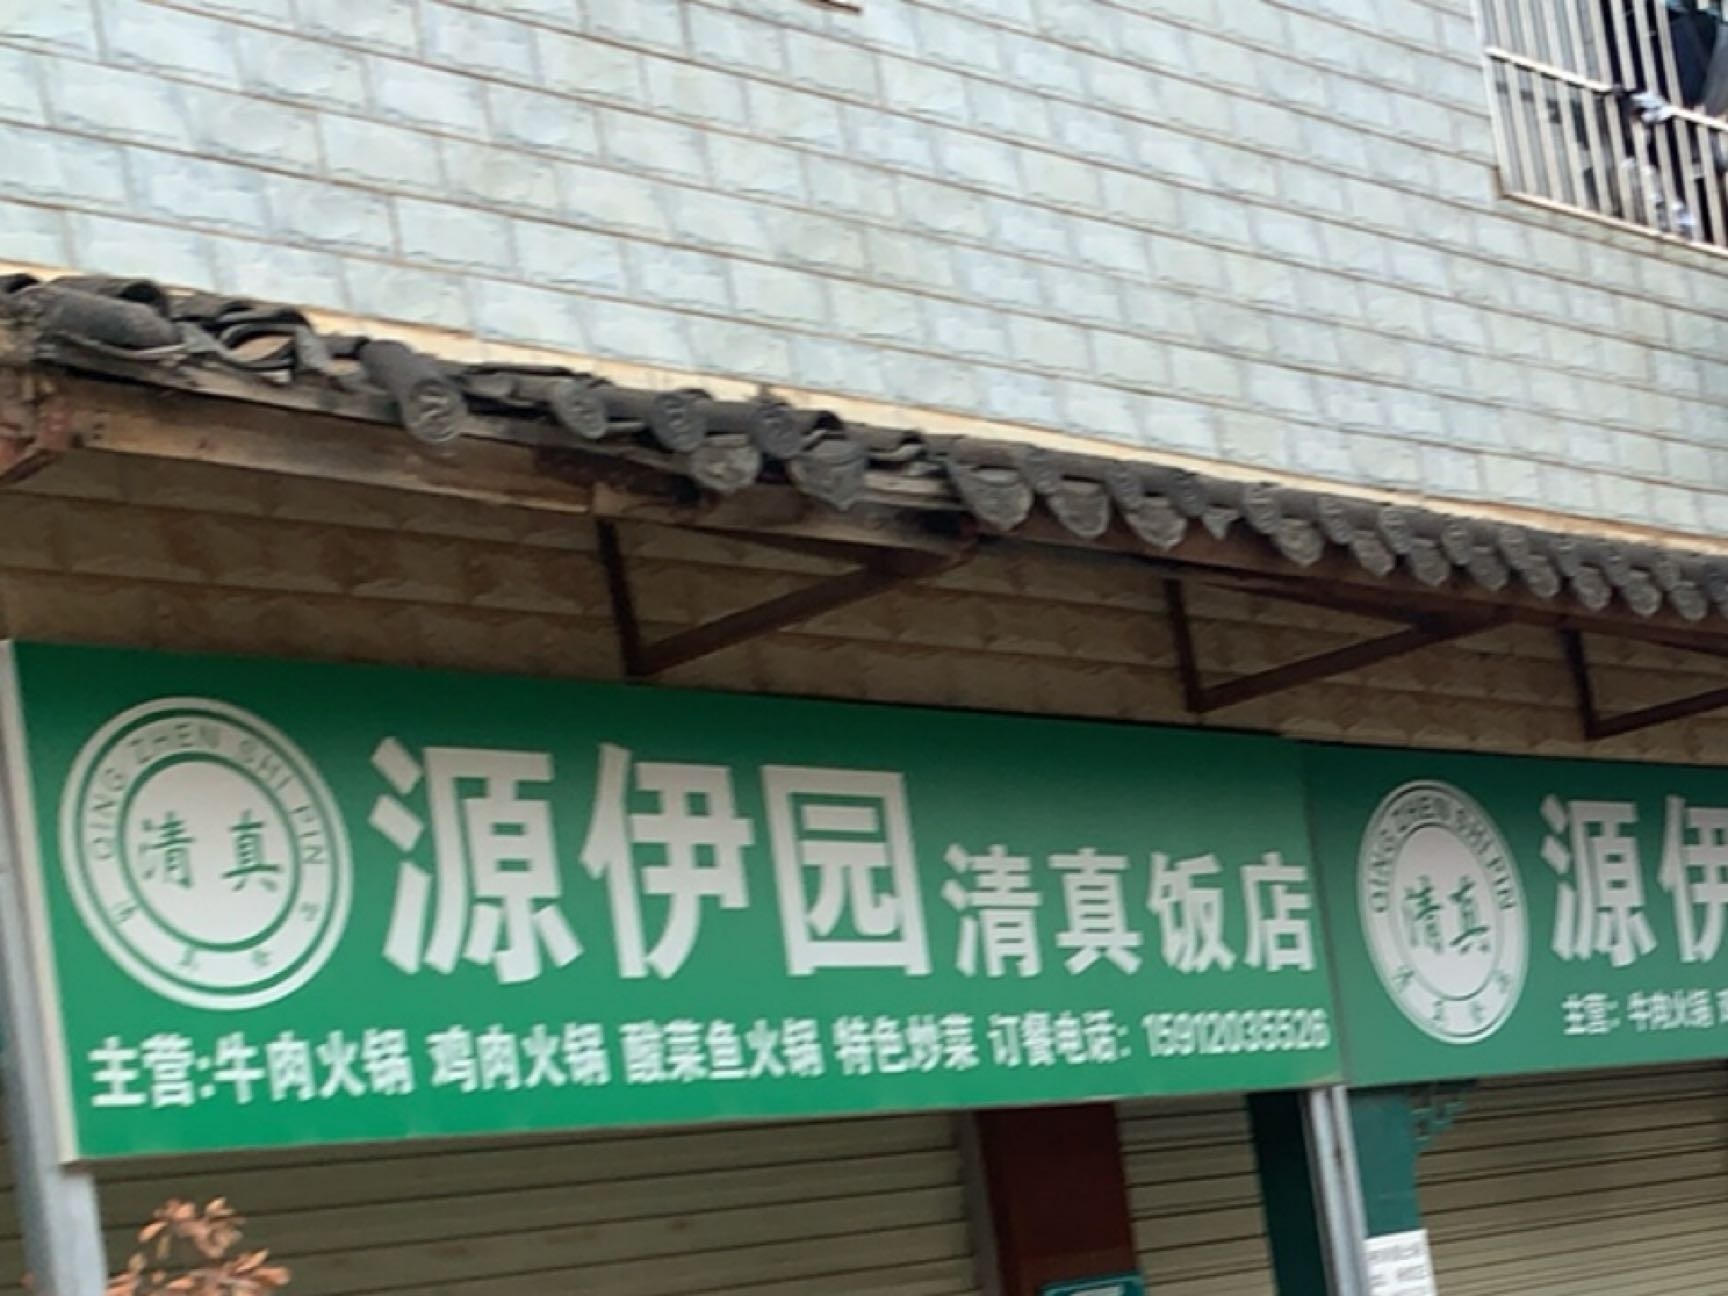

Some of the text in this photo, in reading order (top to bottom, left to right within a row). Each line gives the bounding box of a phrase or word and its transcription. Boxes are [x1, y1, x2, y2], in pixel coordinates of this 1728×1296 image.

[138, 811, 282, 891] 清真
[368, 734, 1316, 984] 源伊园 清真饭店
[1402, 874, 1491, 955] 清真
[425, 1020, 612, 1093] 鸡肉火锅
[618, 1018, 827, 1085] 酸菜鱼火锅
[832, 1013, 981, 1076] 特色炒菜
